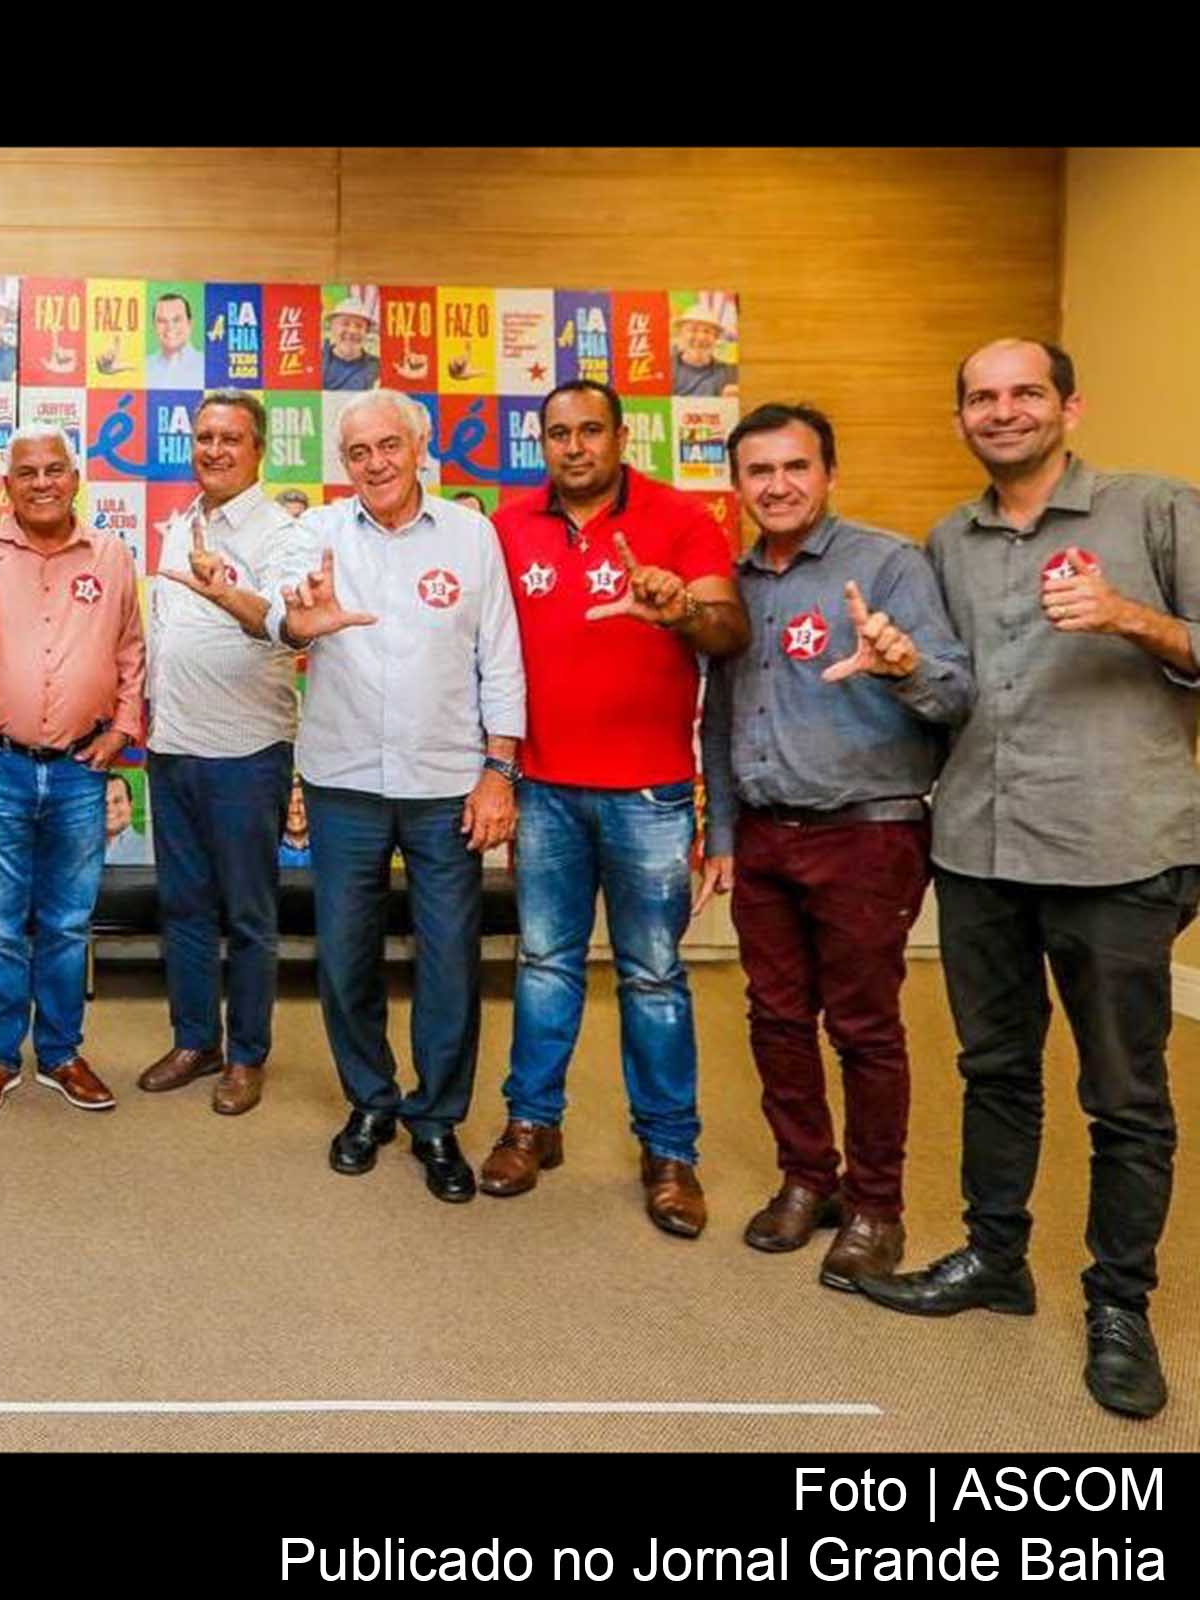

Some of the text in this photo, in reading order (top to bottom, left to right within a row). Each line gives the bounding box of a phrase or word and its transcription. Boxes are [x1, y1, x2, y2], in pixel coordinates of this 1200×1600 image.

[35, 295, 81, 331] FAZ O
[95, 297, 139, 331] FAZ O
[387, 302, 431, 337] FAZ O
[445, 303, 476, 337] FAZ
[478, 303, 489, 337] O
[228, 326, 258, 351] HIA
[158, 406, 191, 433] BA
[271, 406, 315, 436] BRA
[508, 410, 542, 440] BA
[271, 437, 305, 466] SIL
